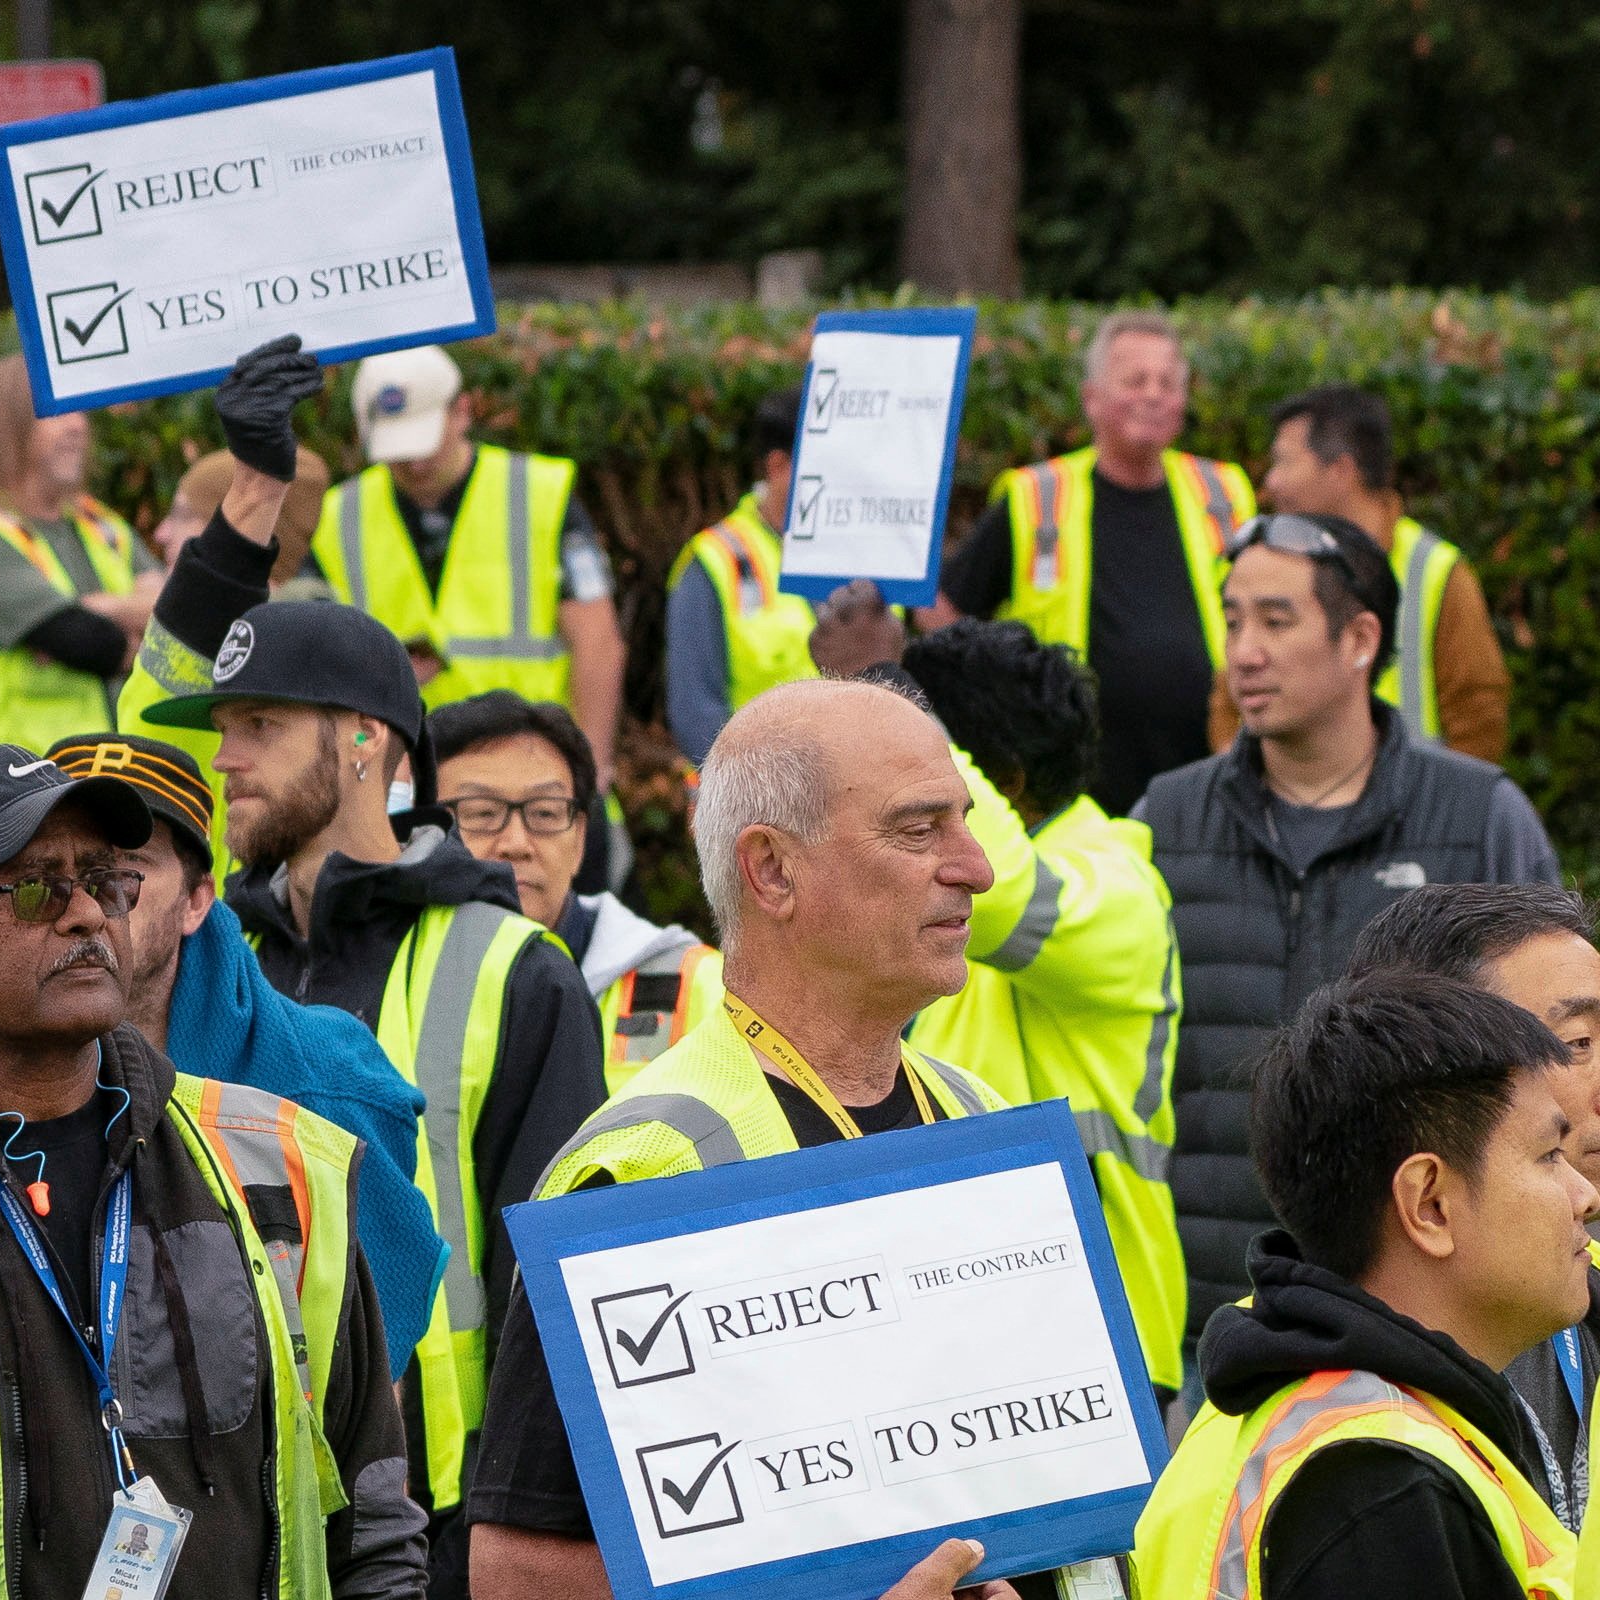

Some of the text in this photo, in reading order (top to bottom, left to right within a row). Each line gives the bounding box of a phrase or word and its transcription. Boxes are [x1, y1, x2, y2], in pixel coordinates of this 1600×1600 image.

[115, 136, 427, 213] REJECT THE CONTRACT
[145, 248, 450, 331] YES TO STRIKE
[837, 390, 890, 418] REJECT
[824, 496, 851, 526] YES
[791, 1062, 804, 1077] 737
[703, 1243, 1068, 1344] REJECT THE CONTRACT
[1563, 1328, 1578, 1369] EING
[755, 1383, 1113, 1494] YES TO STRIKE
